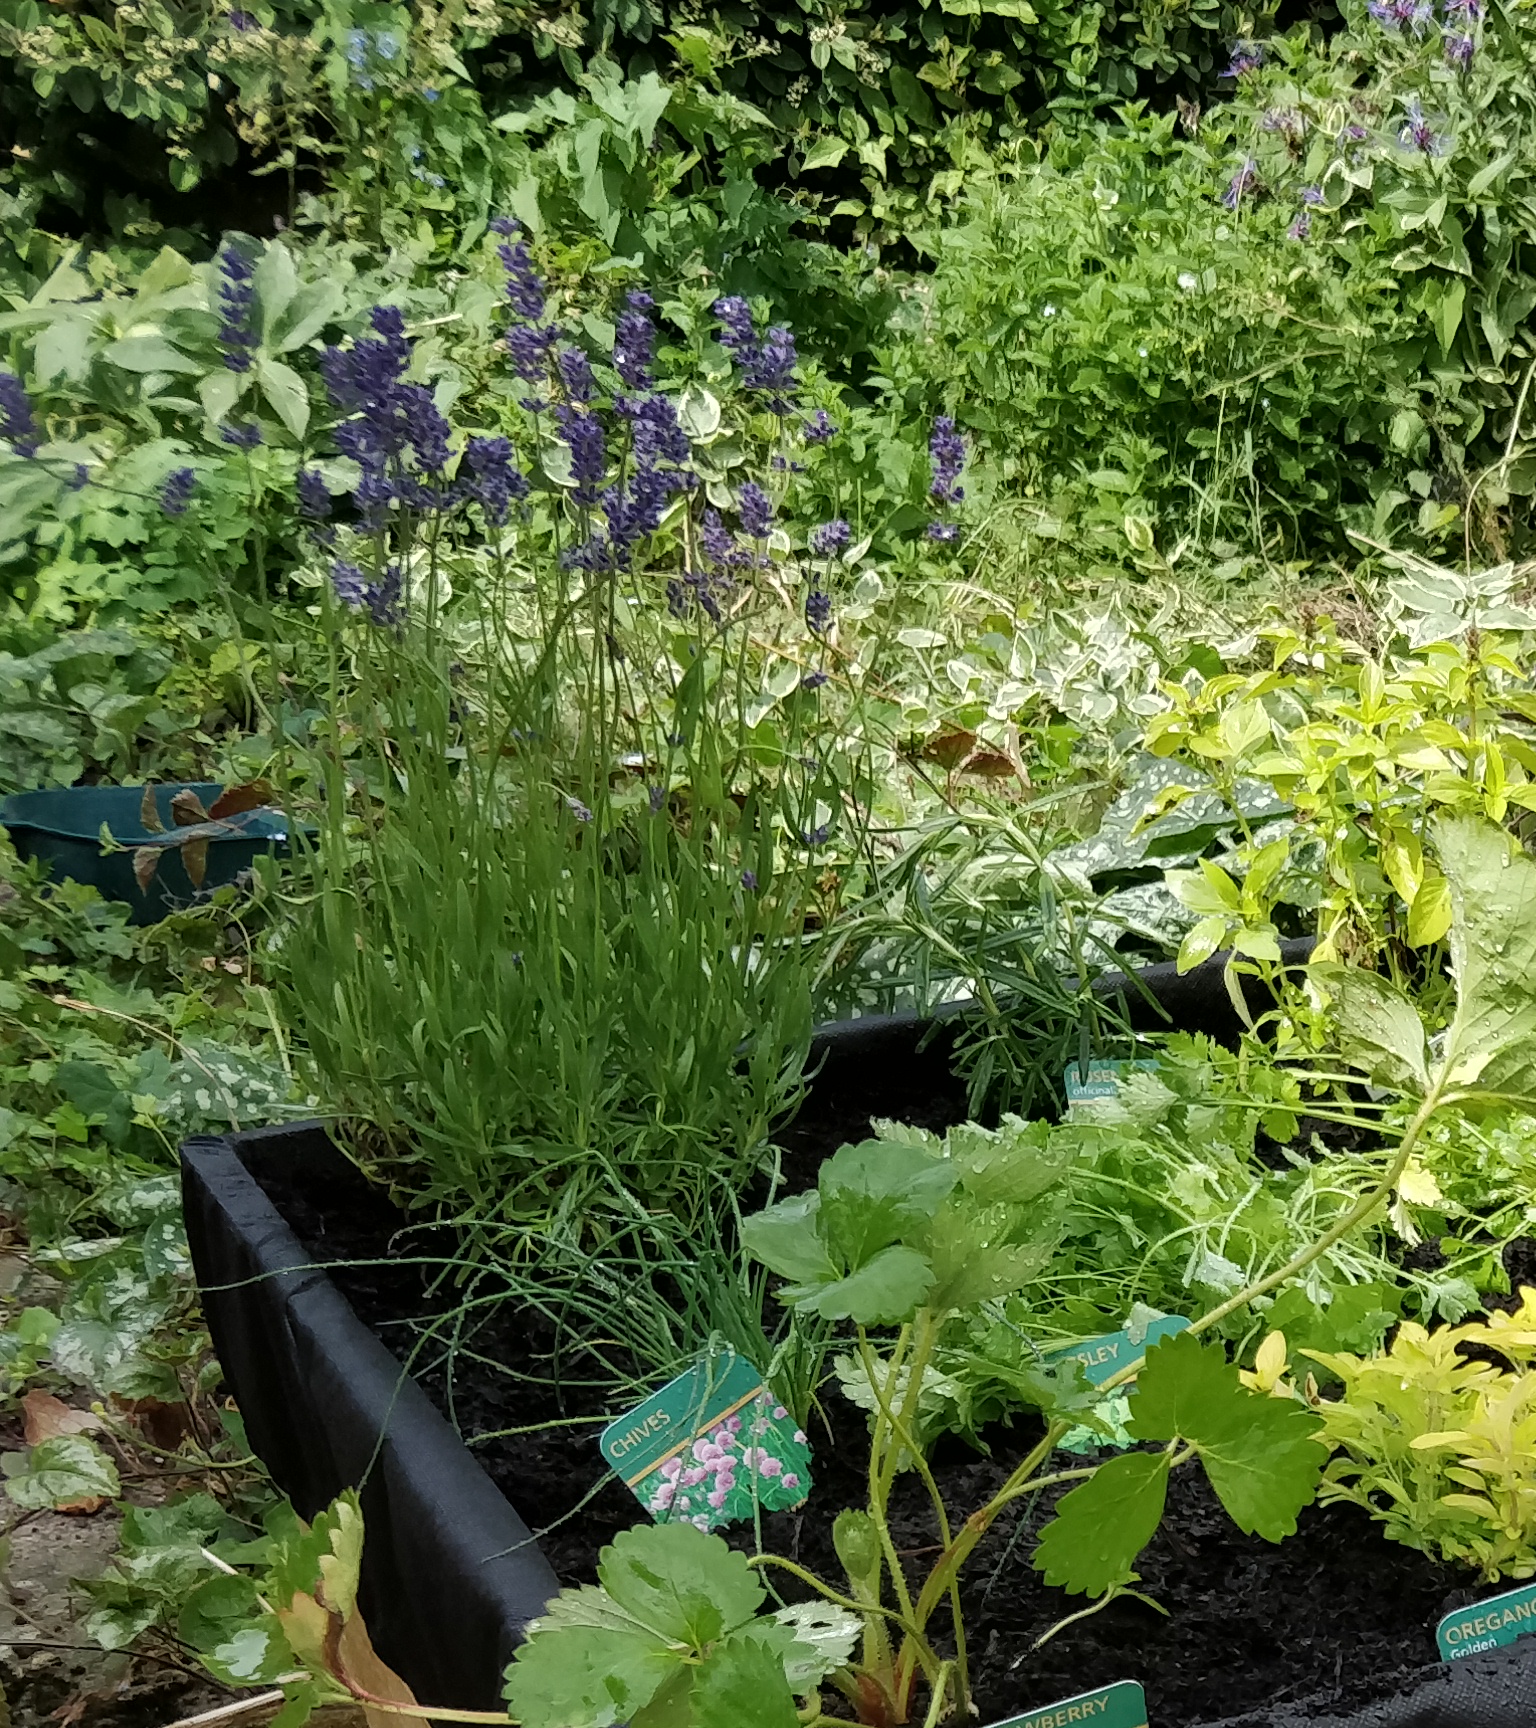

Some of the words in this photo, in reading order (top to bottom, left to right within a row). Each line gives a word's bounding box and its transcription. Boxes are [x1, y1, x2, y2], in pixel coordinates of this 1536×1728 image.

[1076, 1343, 1119, 1368] SLEY
[609, 1409, 671, 1459] CHIVES
[1450, 1634, 1499, 1660] Golden
